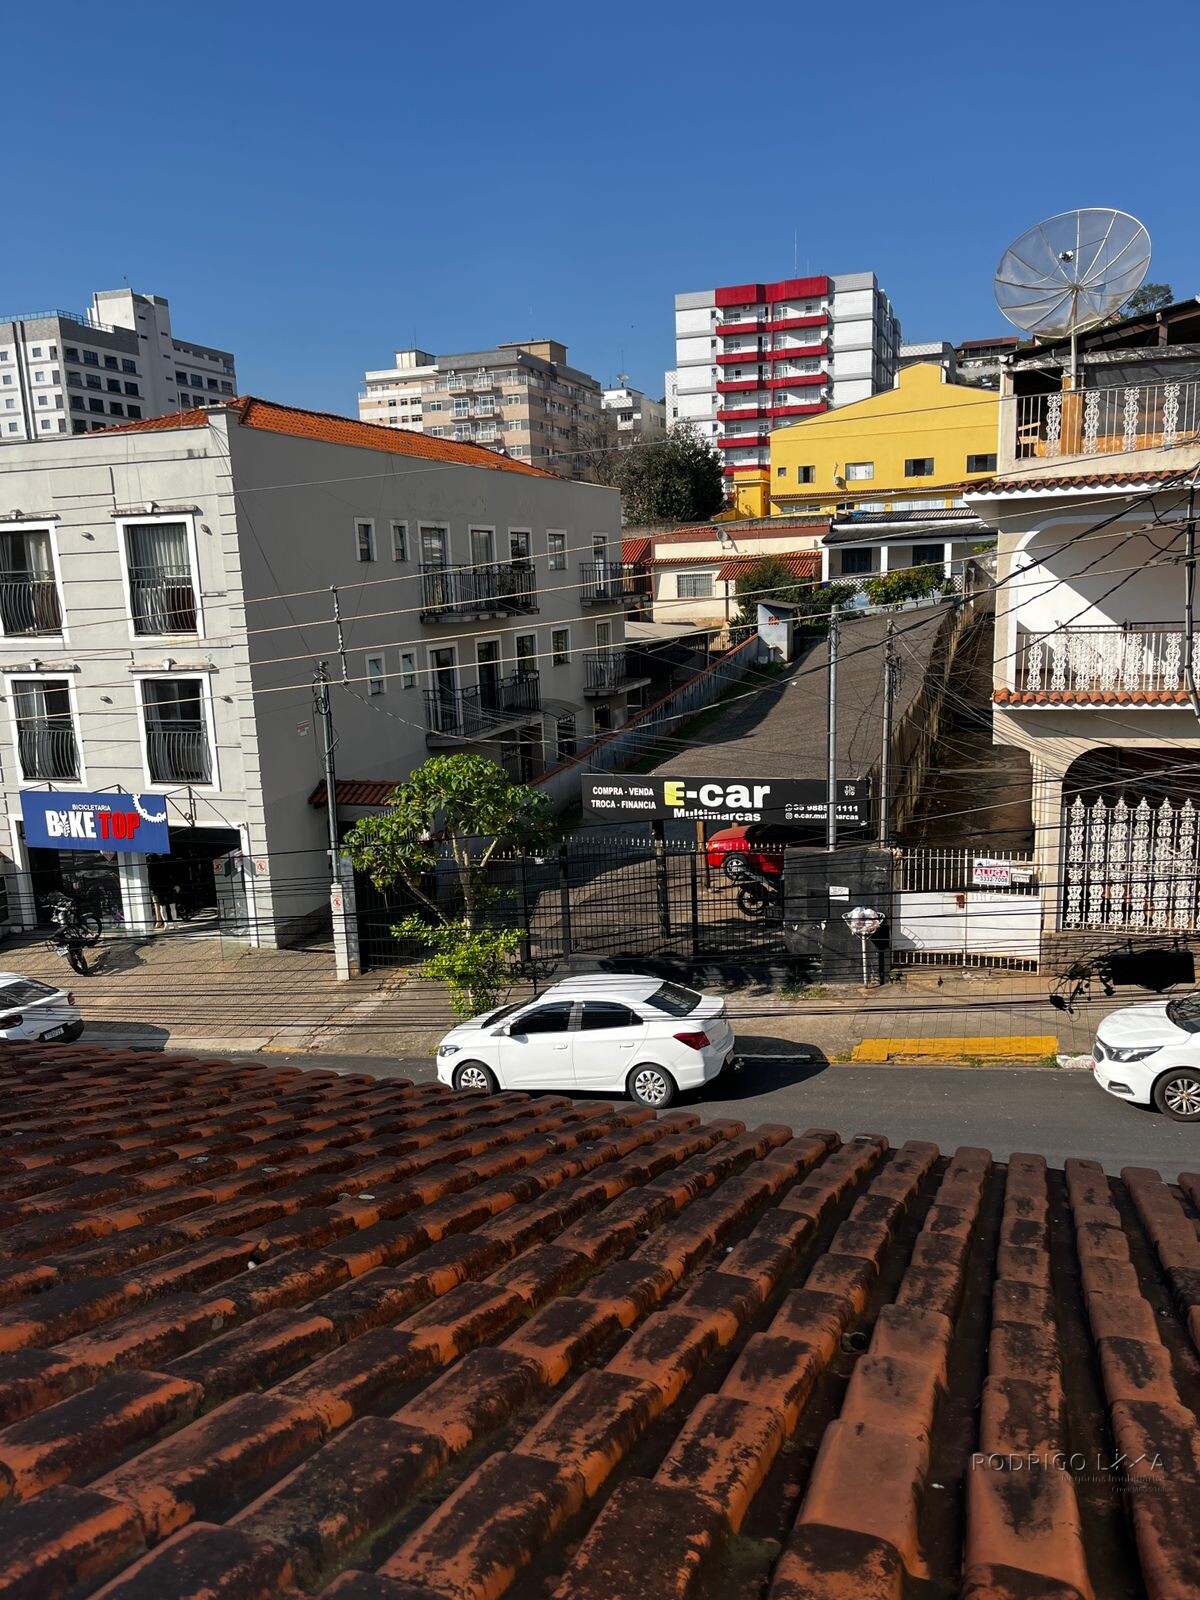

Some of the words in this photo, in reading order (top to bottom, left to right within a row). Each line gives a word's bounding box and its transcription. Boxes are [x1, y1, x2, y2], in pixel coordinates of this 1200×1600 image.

[592, 786, 624, 796] COMPRA
[628, 787, 655, 796] VENDA
[664, 781, 770, 808] E-car
[591, 799, 616, 809] TROCA
[621, 800, 657, 810] FINANCIA
[673, 808, 761, 821] Multimarcas
[45, 810, 97, 838] BIKE
[98, 811, 140, 839] TOP
[976, 869, 1008, 877] ALUGA
